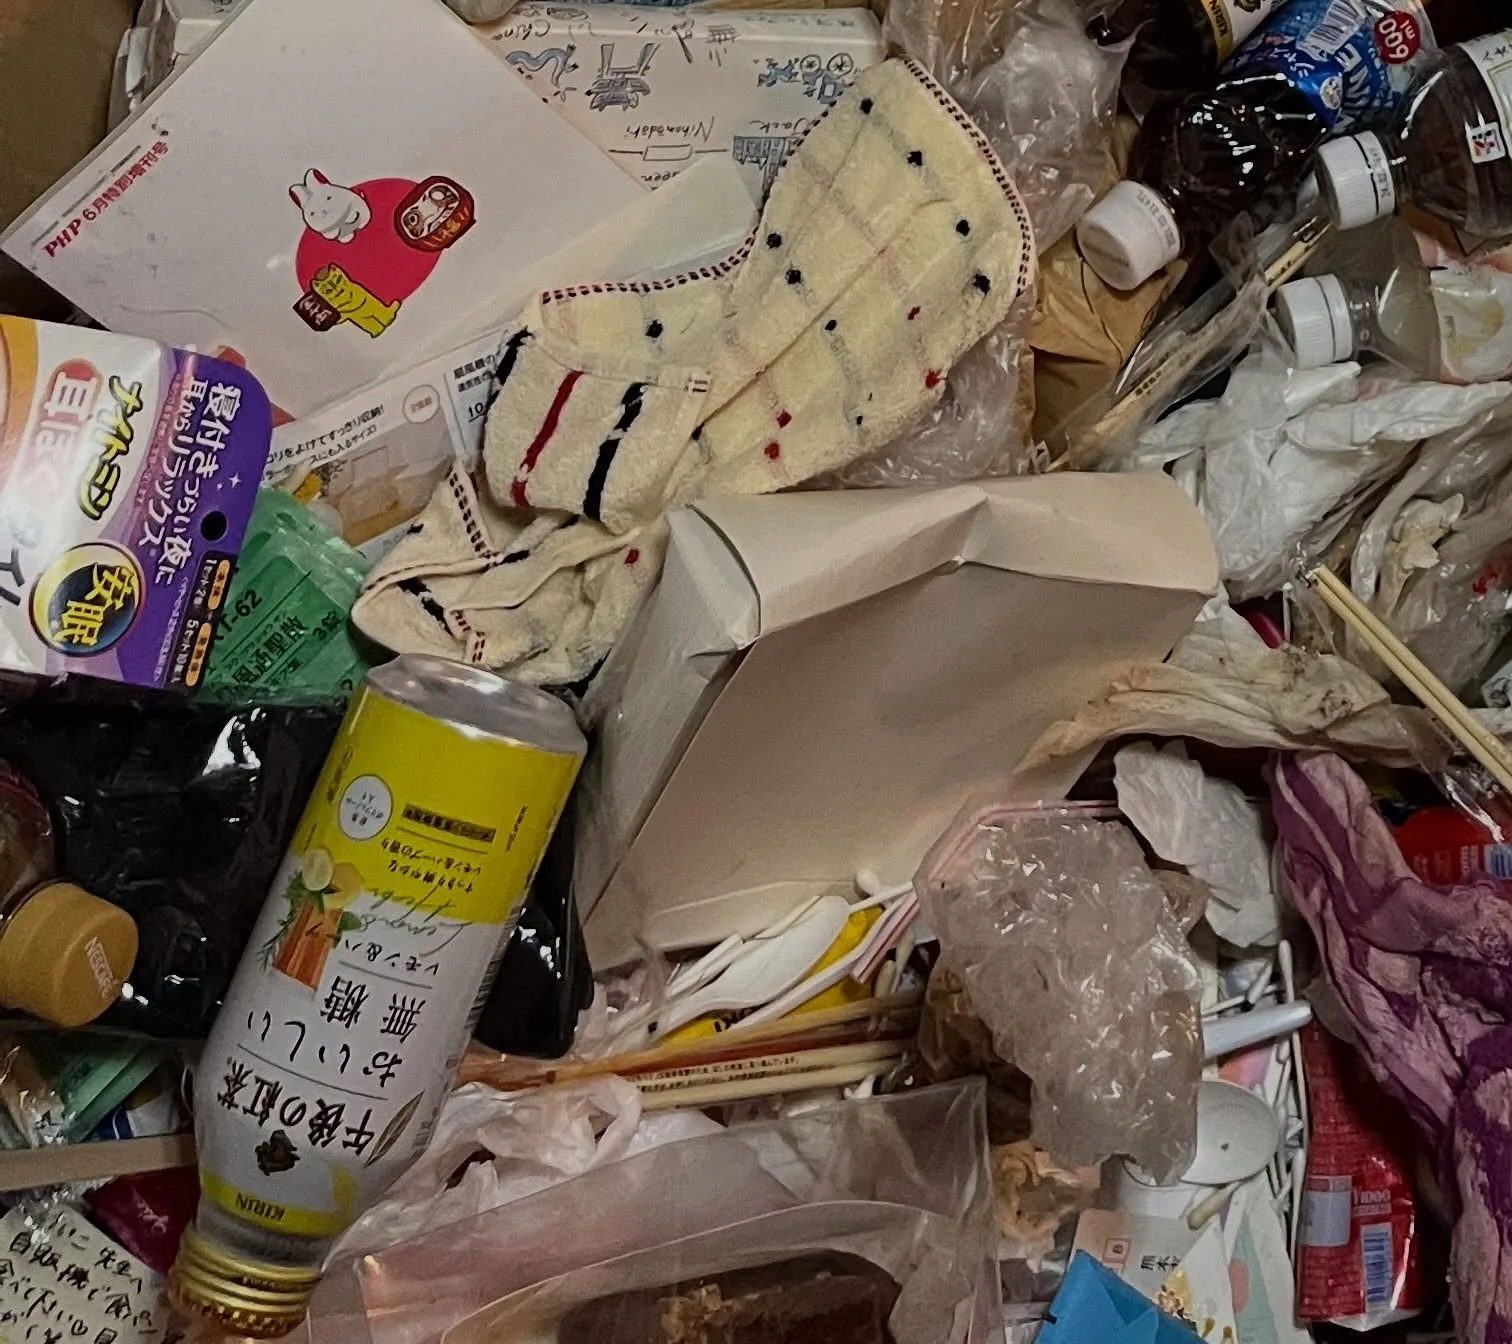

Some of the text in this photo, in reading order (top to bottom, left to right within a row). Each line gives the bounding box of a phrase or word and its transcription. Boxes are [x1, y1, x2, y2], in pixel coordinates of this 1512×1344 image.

[1375, 15, 1412, 63] 600
[1398, 18, 1417, 41] ml
[42, 137, 172, 258] PHP 6月特別増刊号
[71, 374, 148, 522] ナイトミン
[136, 374, 209, 552] 耳からリラックス
[152, 379, 245, 588] 寝付きづらい夜に
[52, 561, 138, 648] 安眠
[385, 858, 475, 894] すっきり爽やかな
[243, 1006, 403, 1089] おいしい
[316, 973, 426, 1046] 無糖
[214, 1059, 377, 1157] 午後の紅茶
